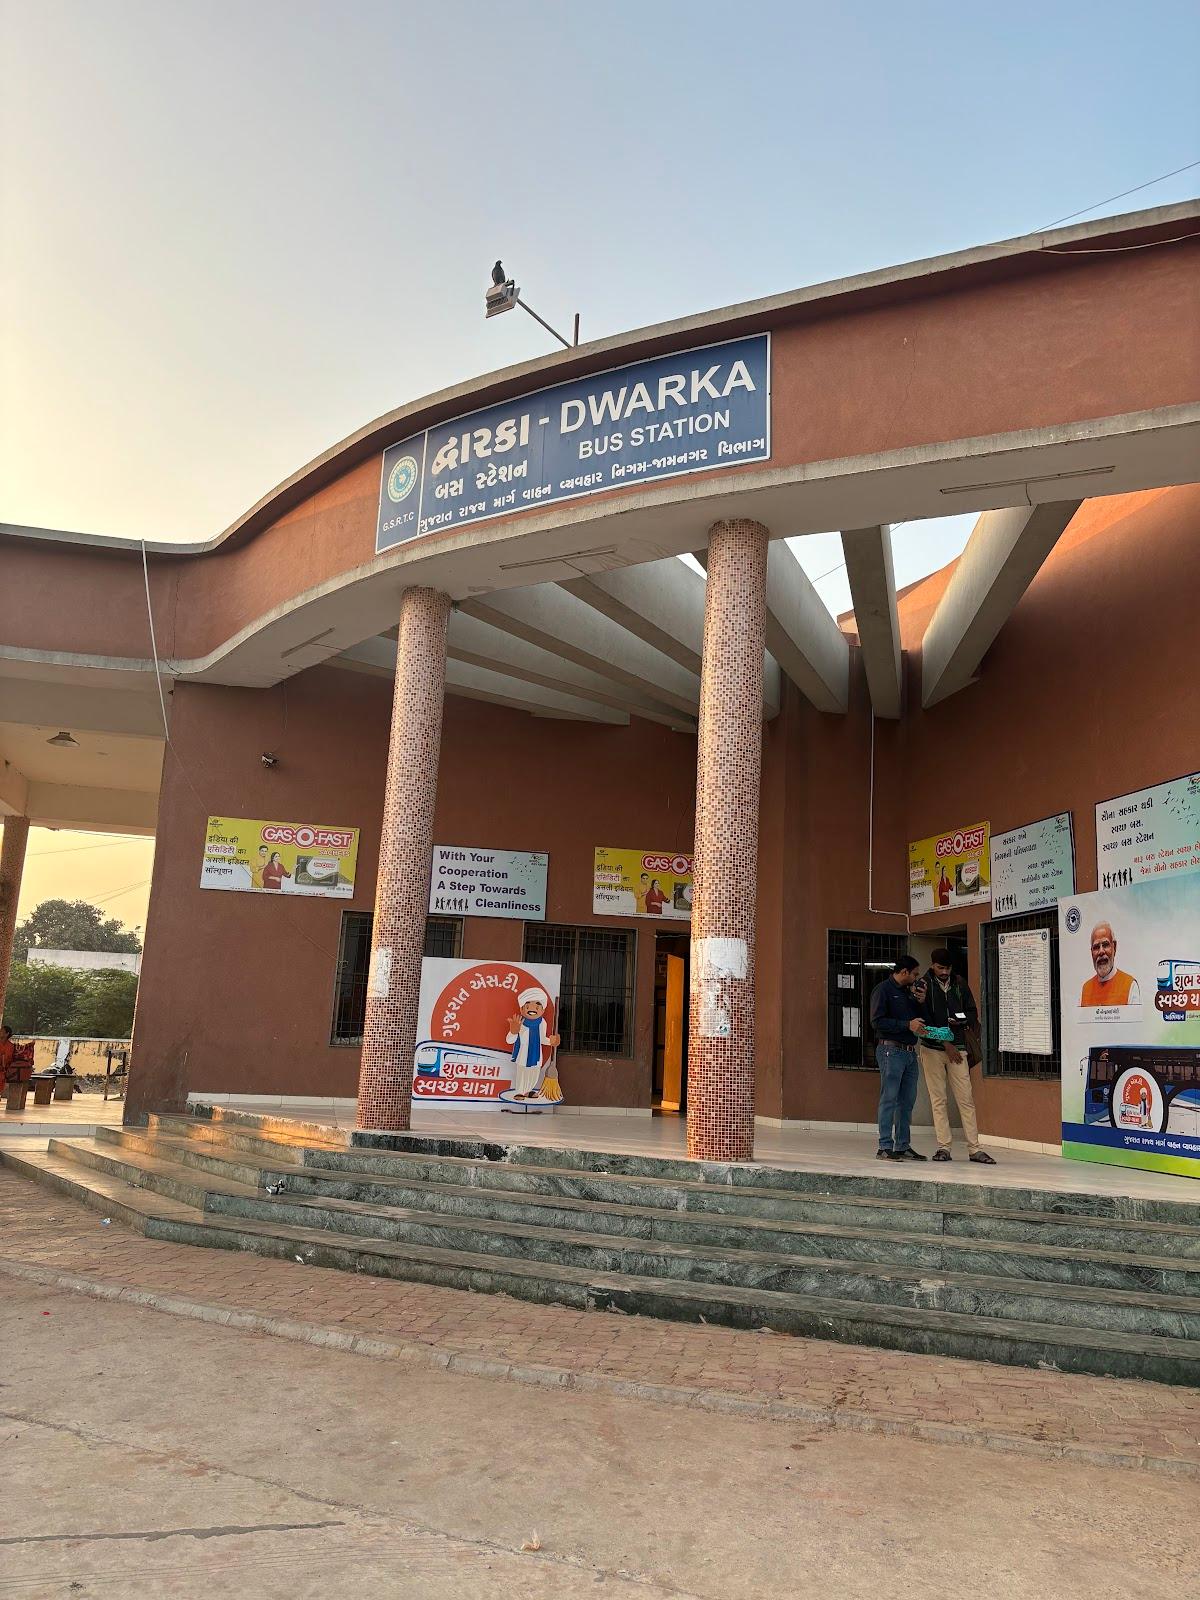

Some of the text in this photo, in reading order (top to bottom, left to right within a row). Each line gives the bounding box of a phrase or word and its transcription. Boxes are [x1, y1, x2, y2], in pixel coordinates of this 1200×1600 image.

[431, 414, 530, 475] દ્વારકા
[560, 360, 757, 434] DWARKA
[578, 409, 730, 460] BUS STATION
[419, 510, 453, 532] ગુજરાત
[493, 489, 515, 508] માર્ગ
[522, 484, 552, 500] વાહન
[559, 472, 603, 489] વ્યવહાર
[718, 438, 765, 457] વિભાગ
[435, 478, 464, 500] બસ
[476, 459, 528, 489] સ્ટેશન
[440, 850, 495, 863] With Your
[438, 865, 509, 879] Cooperation
[437, 880, 527, 896] A Step Towards
[475, 898, 541, 912] Cleanliness
[1174, 975, 1194, 991] શુભ
[442, 972, 519, 1037] ગુજરાત એસ.ટી.
[1157, 993, 1188, 1008] સ્વચ્છ
[442, 1063, 501, 1080] શુભ યાત્રા
[416, 1079, 495, 1095] સ્વચ્છ યાત્રા
